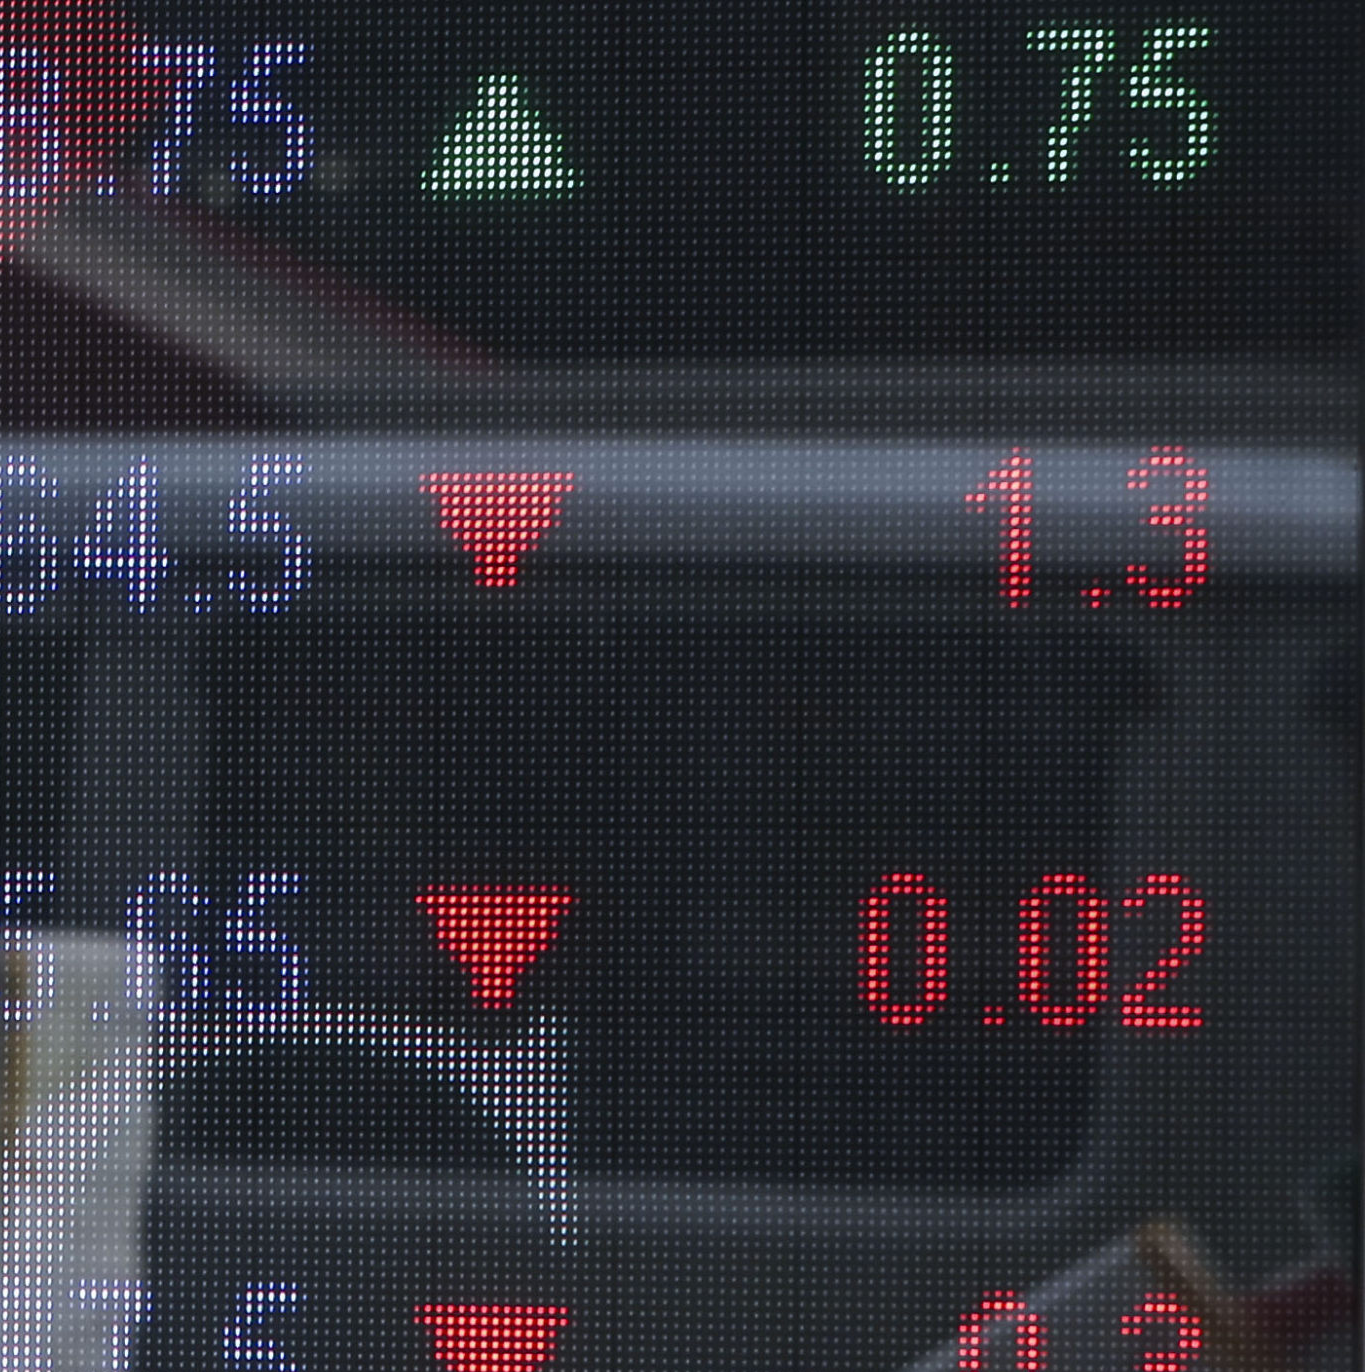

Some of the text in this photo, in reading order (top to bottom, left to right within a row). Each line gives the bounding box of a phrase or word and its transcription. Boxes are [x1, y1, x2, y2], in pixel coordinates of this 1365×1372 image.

[862, 26, 1212, 190] 0.75
[962, 446, 1208, 606] 1.3
[858, 872, 1204, 1030] 0.02
